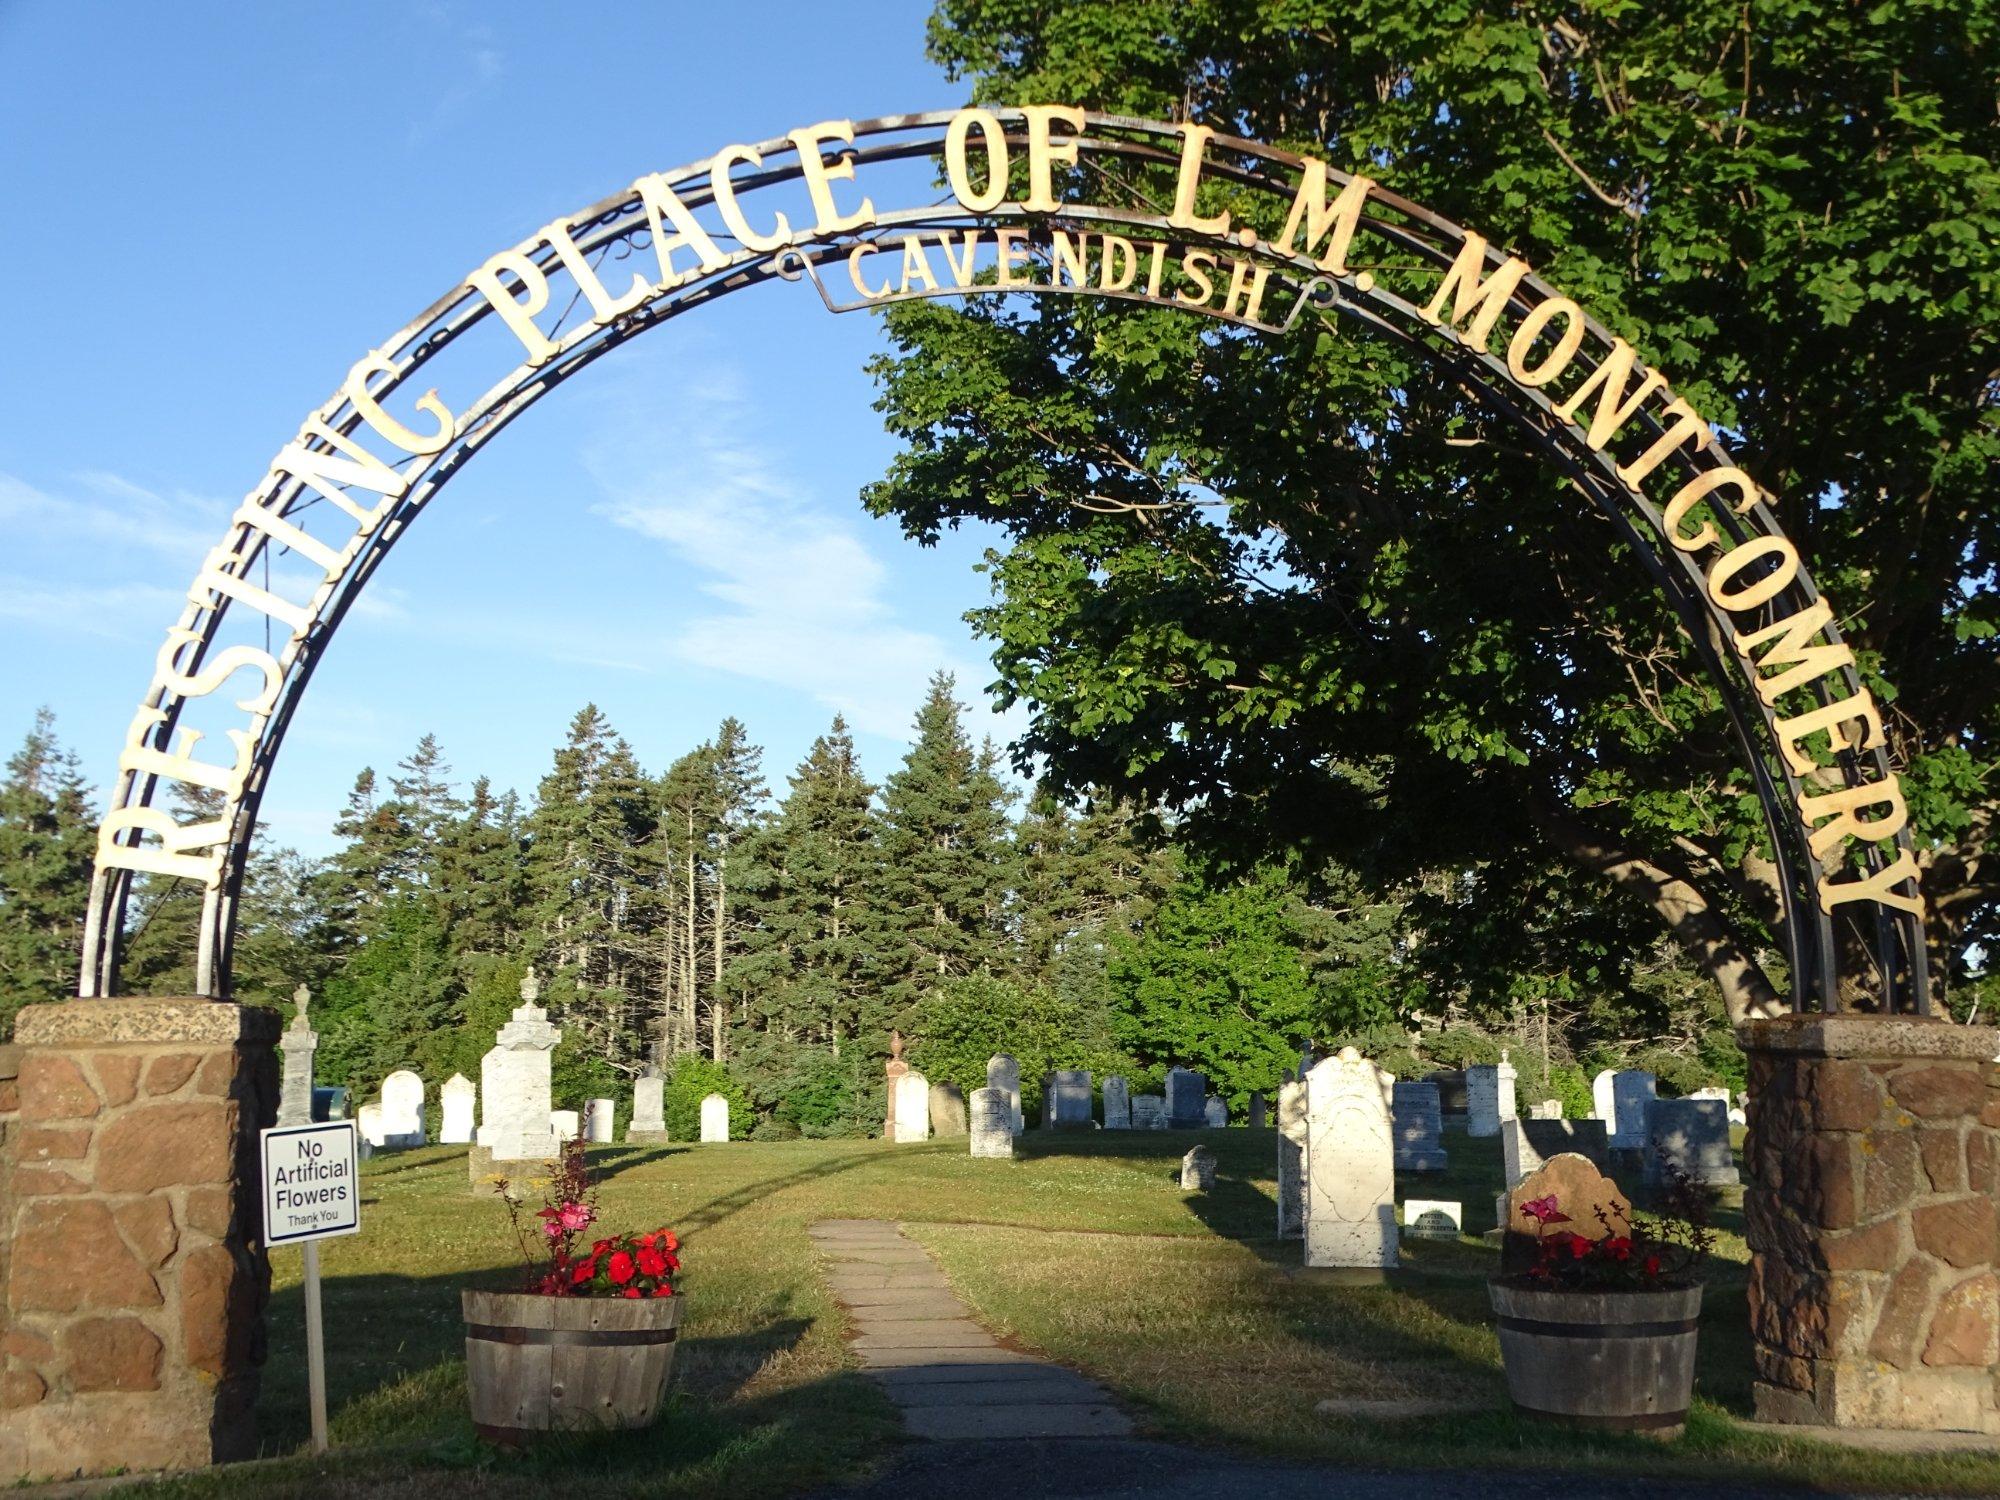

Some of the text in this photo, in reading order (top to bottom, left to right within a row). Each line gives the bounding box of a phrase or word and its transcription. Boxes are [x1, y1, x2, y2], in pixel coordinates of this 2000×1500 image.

[848, 228, 1273, 324] CAVENDISH
[94, 346, 455, 890] RESTING
[465, 119, 877, 367] PLACE
[945, 104, 1086, 213] OF
[1415, 230, 1926, 921] MONTGOMERY
[298, 1139, 323, 1159] No
[274, 1158, 348, 1186] Artificial
[276, 1185, 347, 1210] Flowers
[288, 1209, 339, 1227] Thank You
